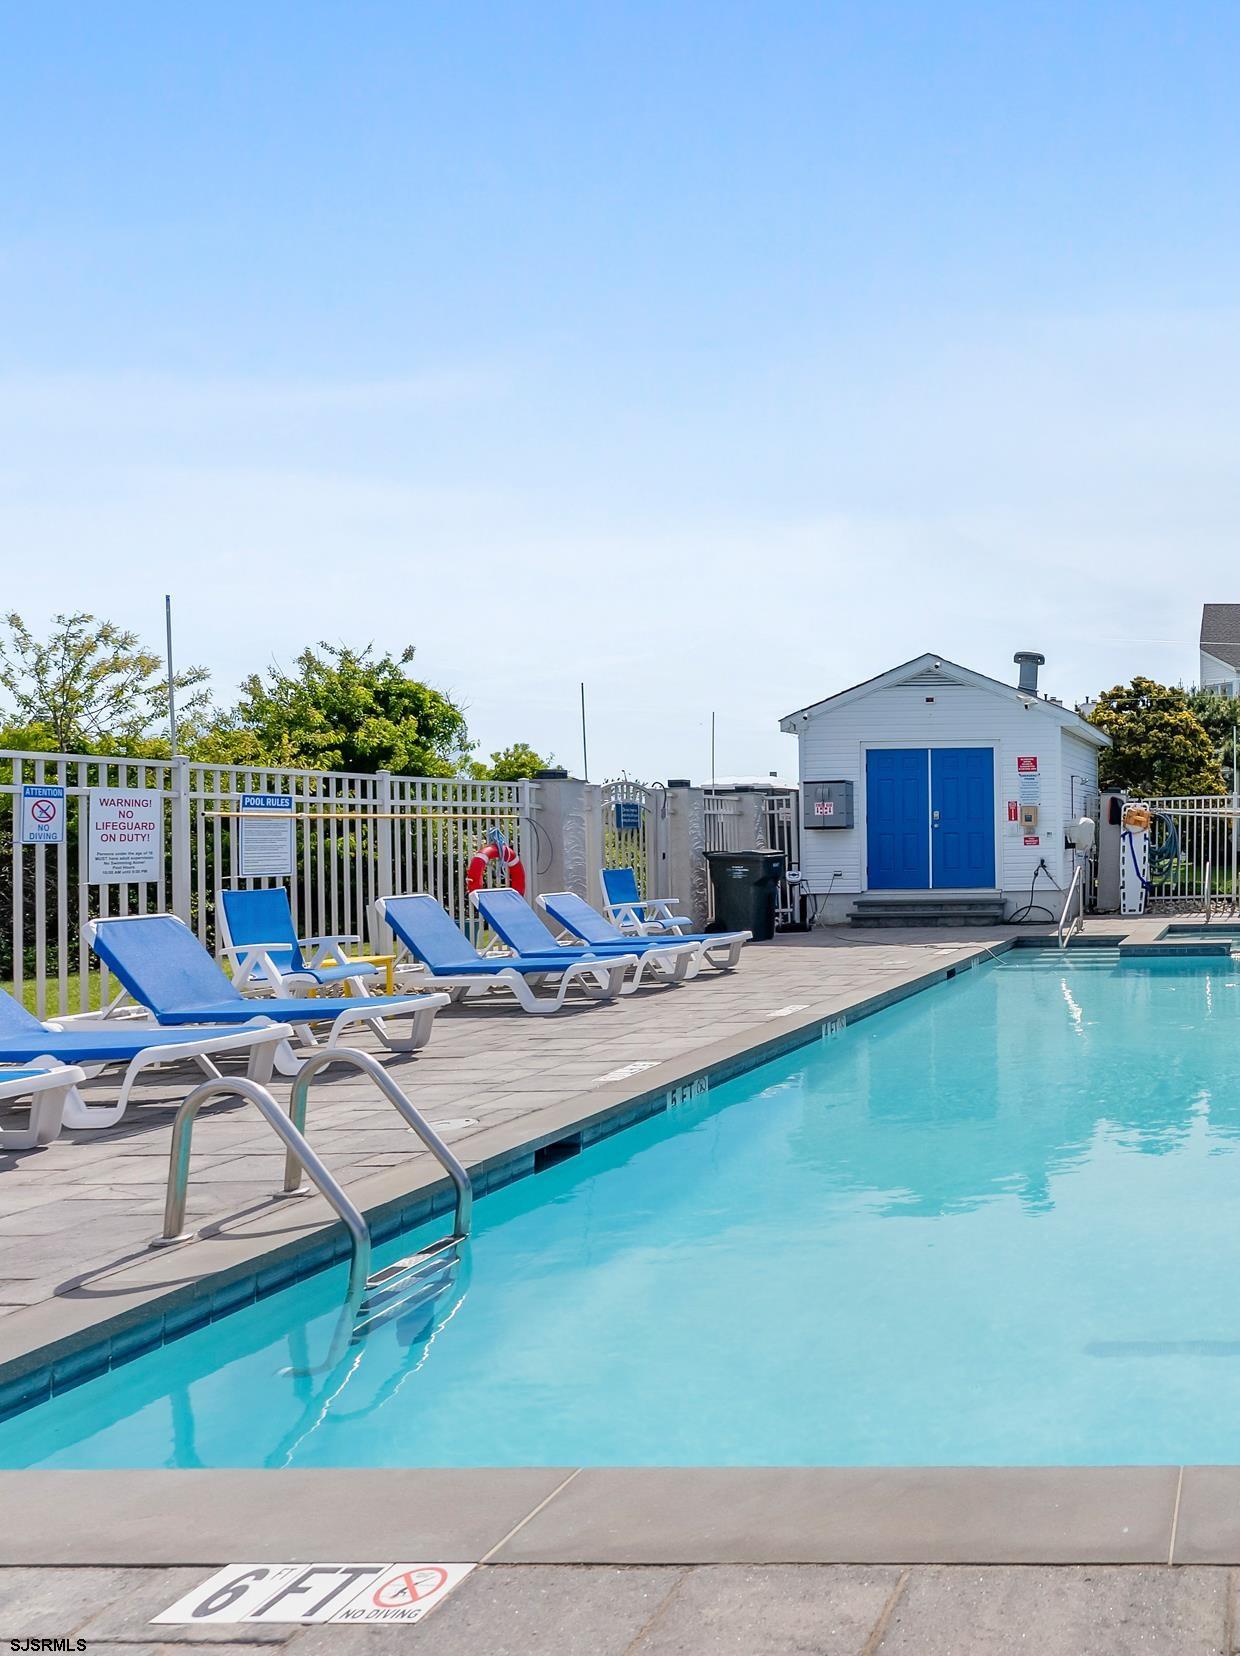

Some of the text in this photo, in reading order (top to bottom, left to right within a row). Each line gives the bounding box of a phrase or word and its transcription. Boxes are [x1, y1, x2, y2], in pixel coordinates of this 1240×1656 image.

[25, 788, 63, 797] ATTENTION
[99, 798, 152, 808] WARNING!
[244, 797, 290, 807] POOL RULES
[118, 810, 134, 819] NO
[37, 824, 50, 832] NO
[95, 821, 156, 831] LIFEGUARD
[29, 832, 58, 840] DIVING
[100, 833, 150, 842] ON DUTY!
[191, 1567, 385, 1618] 6 FT
[339, 1608, 422, 1619] NO DIVING
